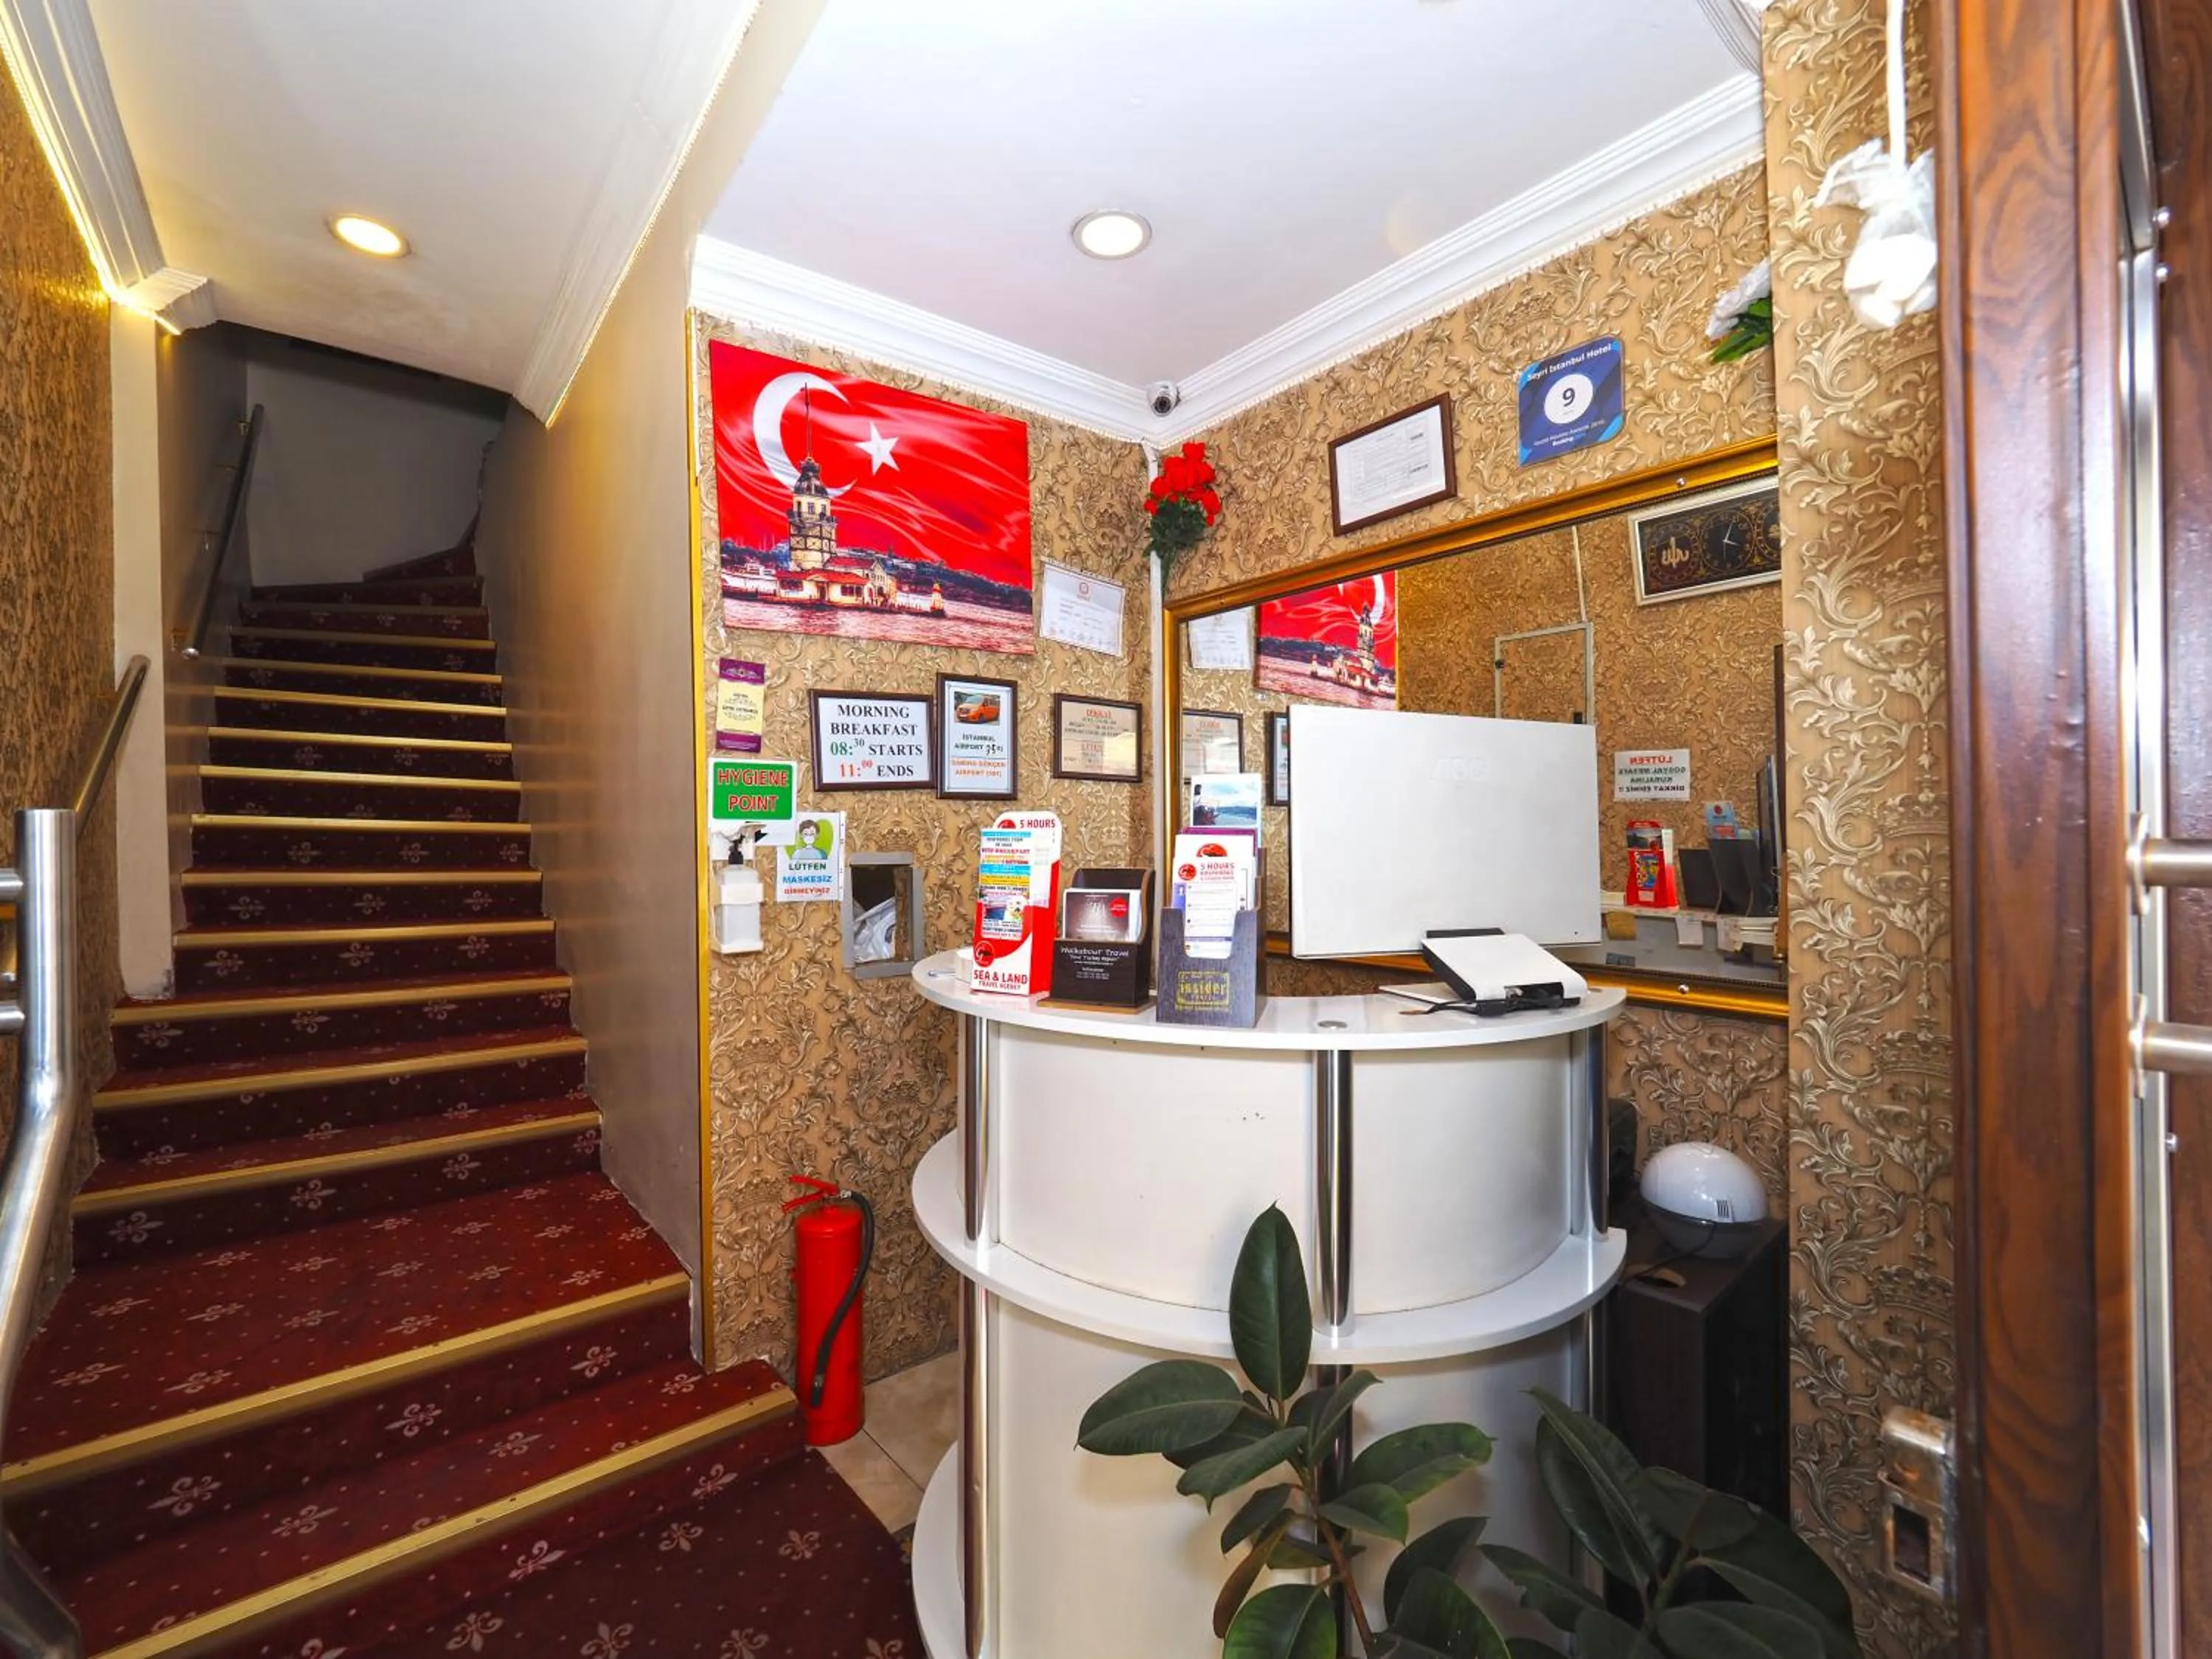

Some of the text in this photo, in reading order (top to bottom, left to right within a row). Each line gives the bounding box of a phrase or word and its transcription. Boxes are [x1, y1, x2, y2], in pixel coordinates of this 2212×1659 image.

[1587, 344, 1611, 359] Hotel
[1562, 387, 1576, 407] 9
[838, 704, 909, 718] MORNING
[830, 722, 918, 736] BREAKFAST
[869, 744, 922, 756] STARTS
[718, 768, 788, 787] HYGIENE
[877, 765, 914, 777] ENDS
[728, 795, 778, 812] POINT
[1020, 818, 1056, 828] 5 HOURS
[788, 861, 827, 871] LÜTFEN
[1207, 862, 1234, 870] HOURS
[973, 970, 1028, 984] SEA & LAND
[978, 980, 998, 988] TRAVEL
